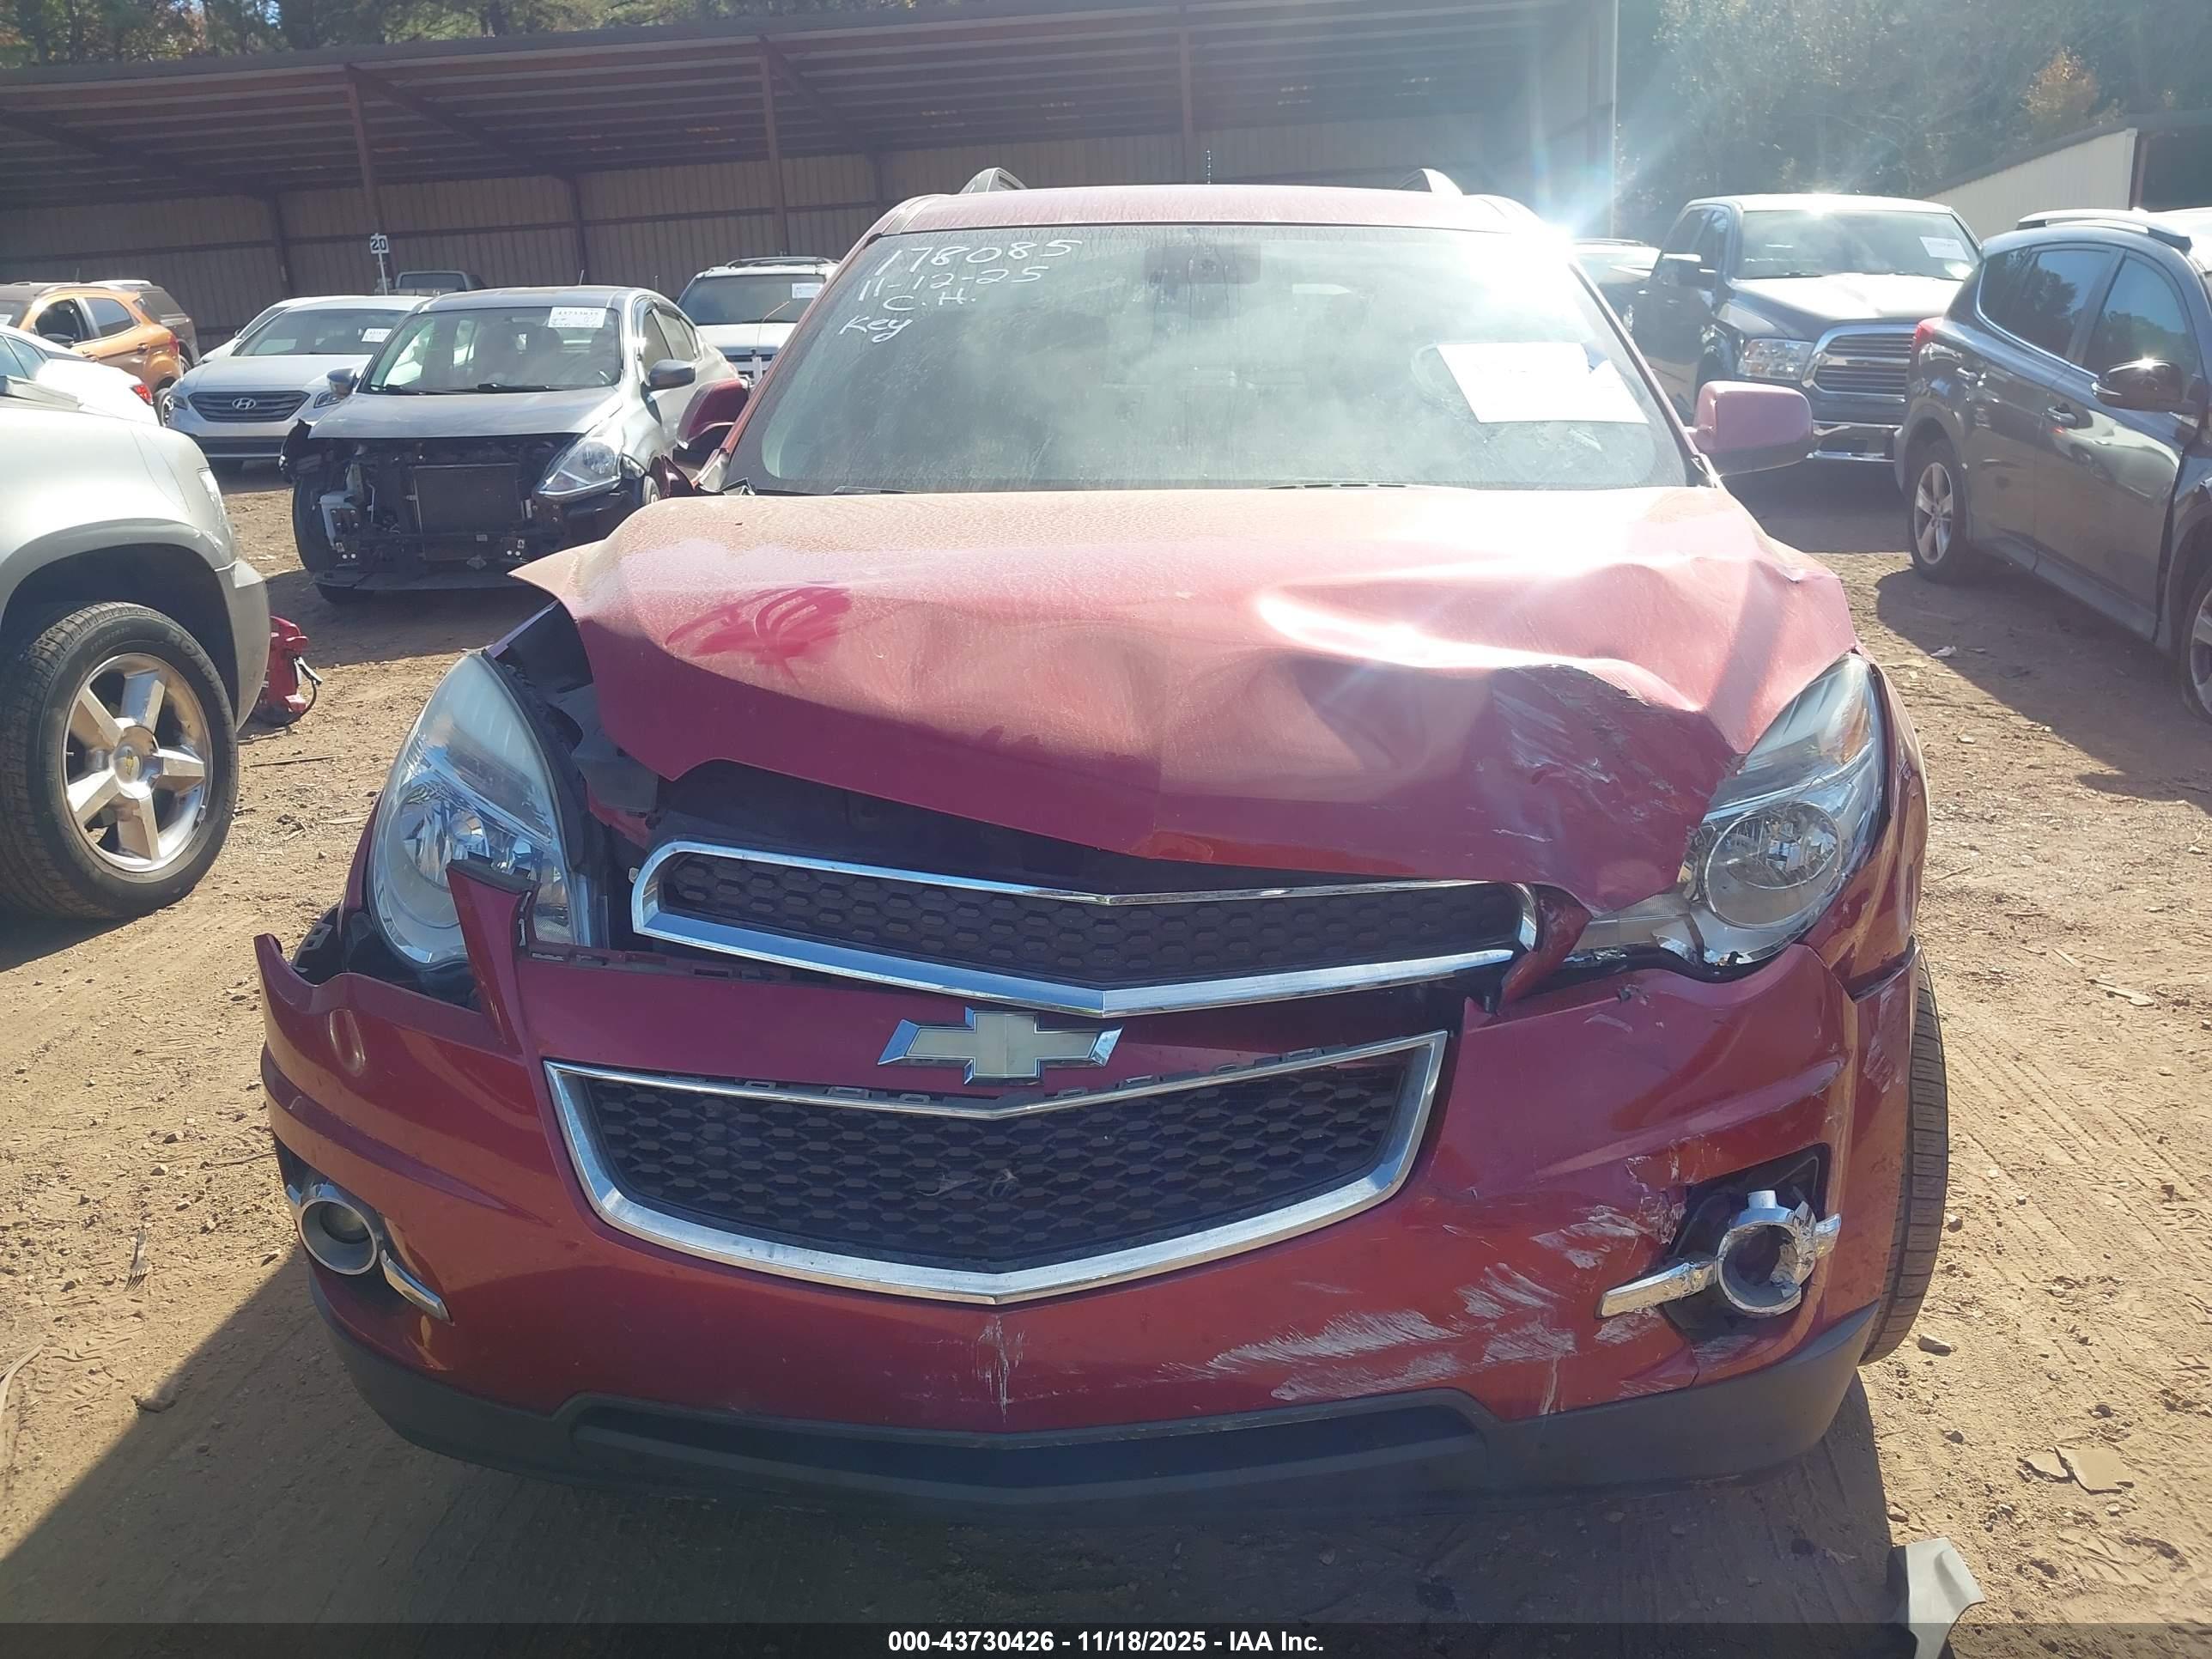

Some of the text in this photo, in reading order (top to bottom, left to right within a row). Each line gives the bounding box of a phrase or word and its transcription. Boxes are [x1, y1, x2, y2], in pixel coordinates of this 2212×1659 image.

[370, 238, 387, 251] 20
[874, 239, 1083, 276] 178085
[859, 266, 1049, 301] 11-12-25
